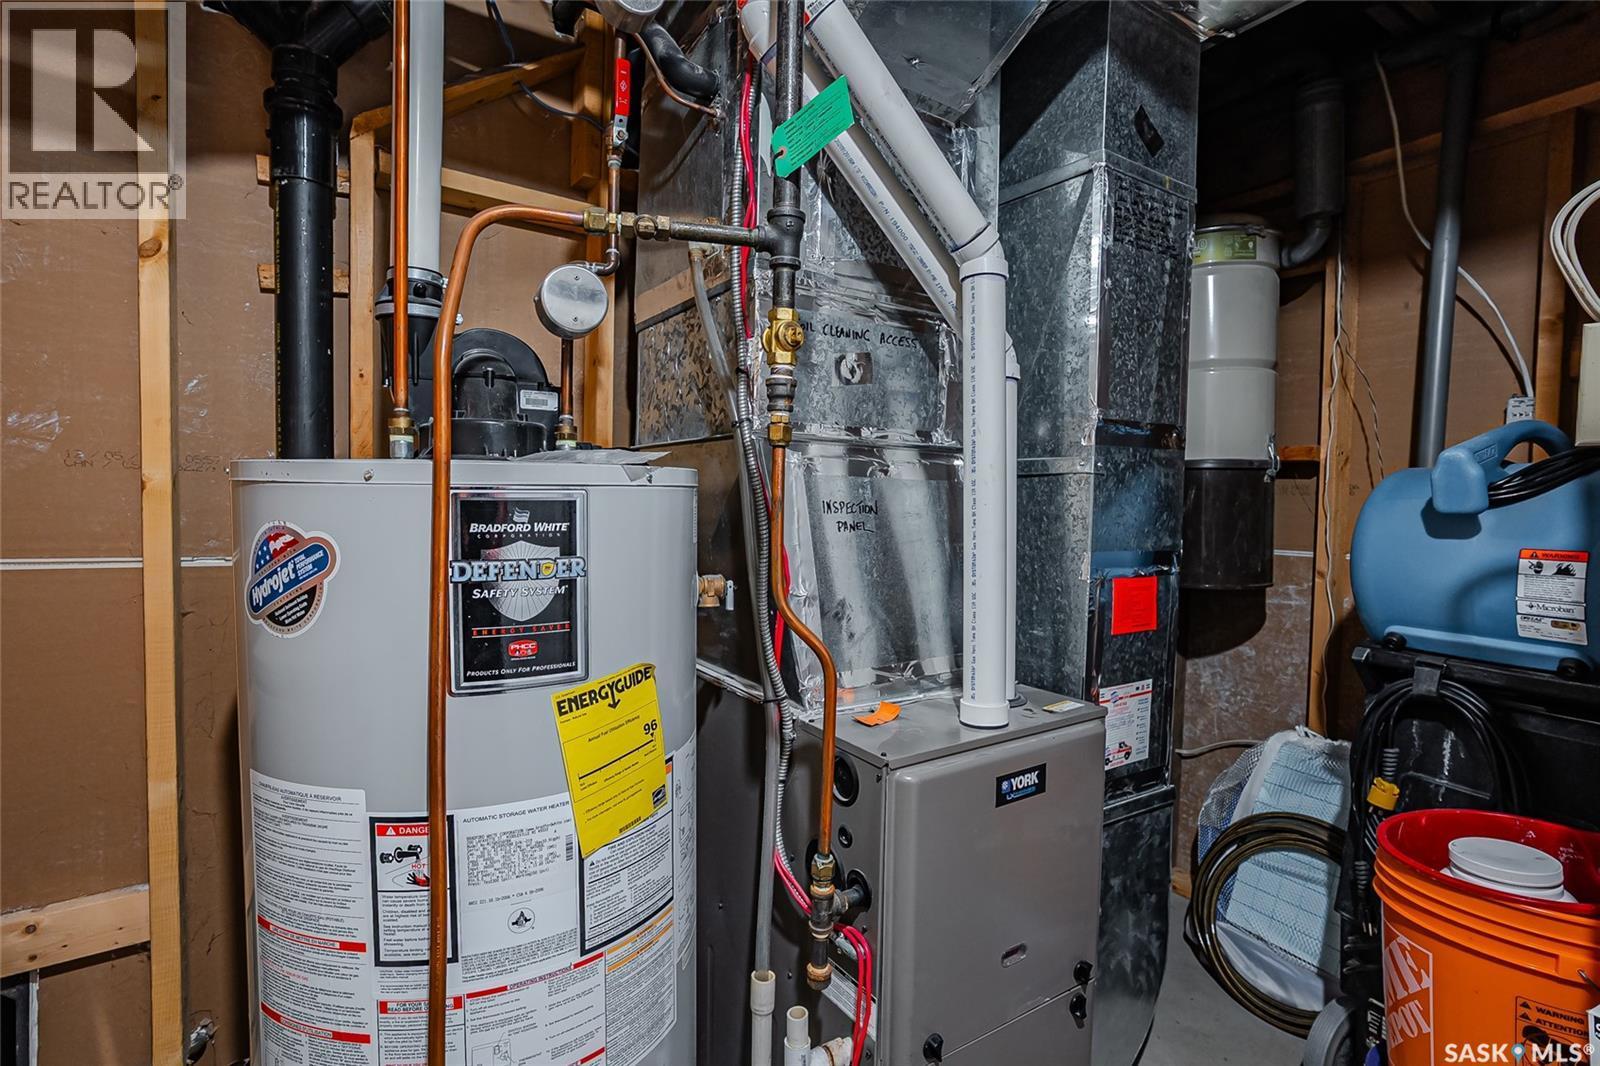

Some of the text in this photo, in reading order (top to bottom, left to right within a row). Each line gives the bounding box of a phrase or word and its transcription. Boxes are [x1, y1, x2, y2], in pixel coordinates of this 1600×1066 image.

[822, 322, 871, 342] CLEANING
[880, 332, 920, 350] ACCESS
[822, 500, 879, 515] INSPECTION
[470, 522, 569, 533] BRADFORD WHITE
[836, 522, 874, 533] PANEL
[450, 557, 586, 583] DEFENDER
[252, 560, 295, 607] Hydrojet
[472, 586, 567, 599] SAFETY SYSTEM
[473, 622, 571, 636] ENERGY SAVER
[510, 642, 536, 650] PHCC
[466, 669, 499, 677] PRODUCTS
[532, 662, 576, 672] PROFESSIONALS
[556, 666, 658, 717] ENERGYGUIDE
[643, 719, 658, 735] 96
[1010, 770, 1040, 791] YORK
[462, 800, 570, 823] AUTOMATIC STORAGE WATER HEATER
[399, 826, 430, 835] DANGE
[1535, 1006, 1585, 1025] WARNING
